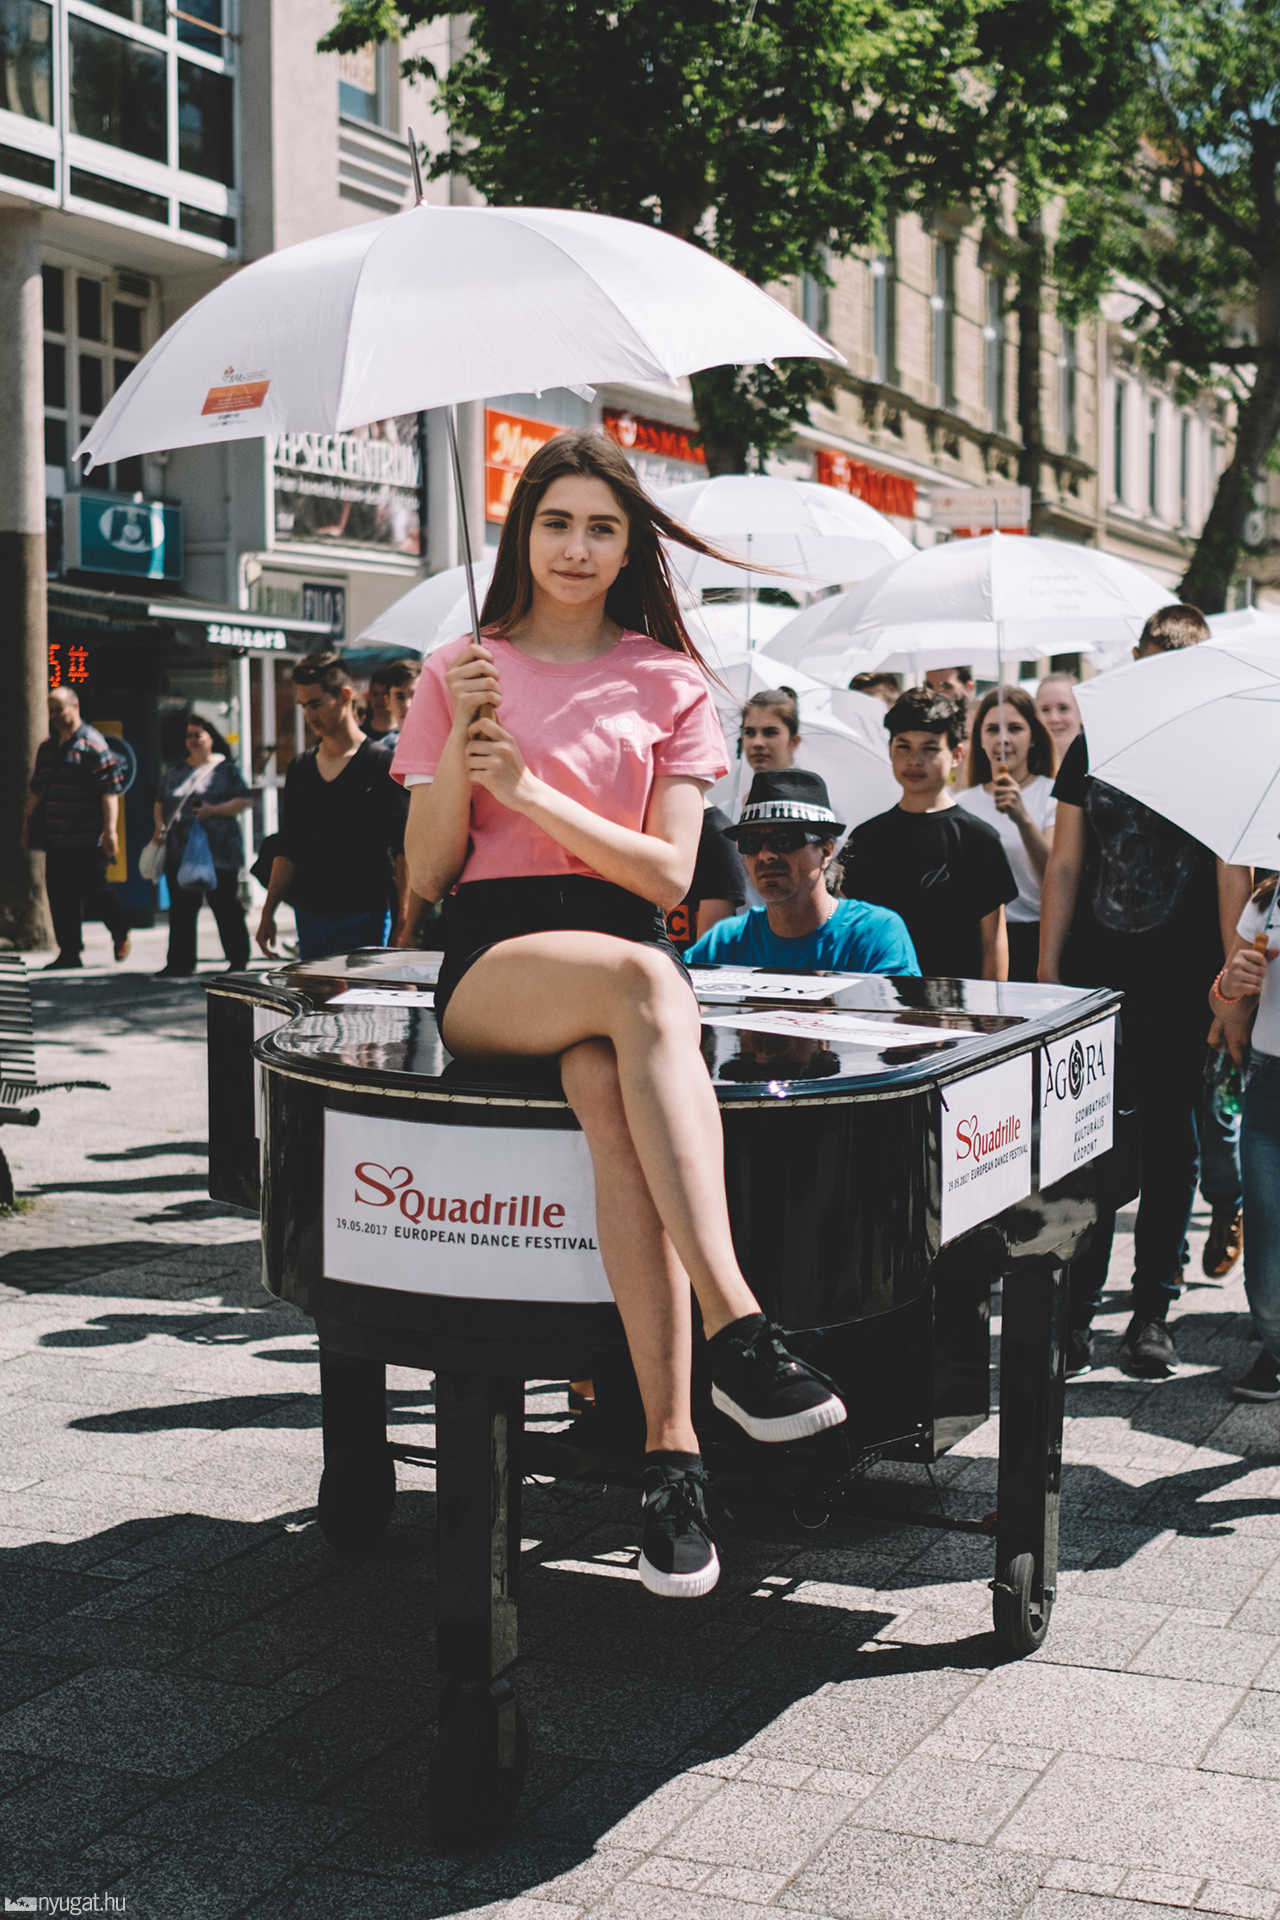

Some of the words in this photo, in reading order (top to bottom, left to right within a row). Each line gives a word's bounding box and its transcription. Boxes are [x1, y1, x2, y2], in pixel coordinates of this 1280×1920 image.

[971, 1160, 994, 1180] EUROPEAN
[994, 1152, 1009, 1169] DANCE
[1009, 1144, 1028, 1160] FESTIVAL
[336, 1218, 388, 1236] 19.05.2017
[394, 1226, 466, 1244] EUROPEAN
[471, 1233, 520, 1248] DANCE
[525, 1236, 598, 1250] FESTIVAL
